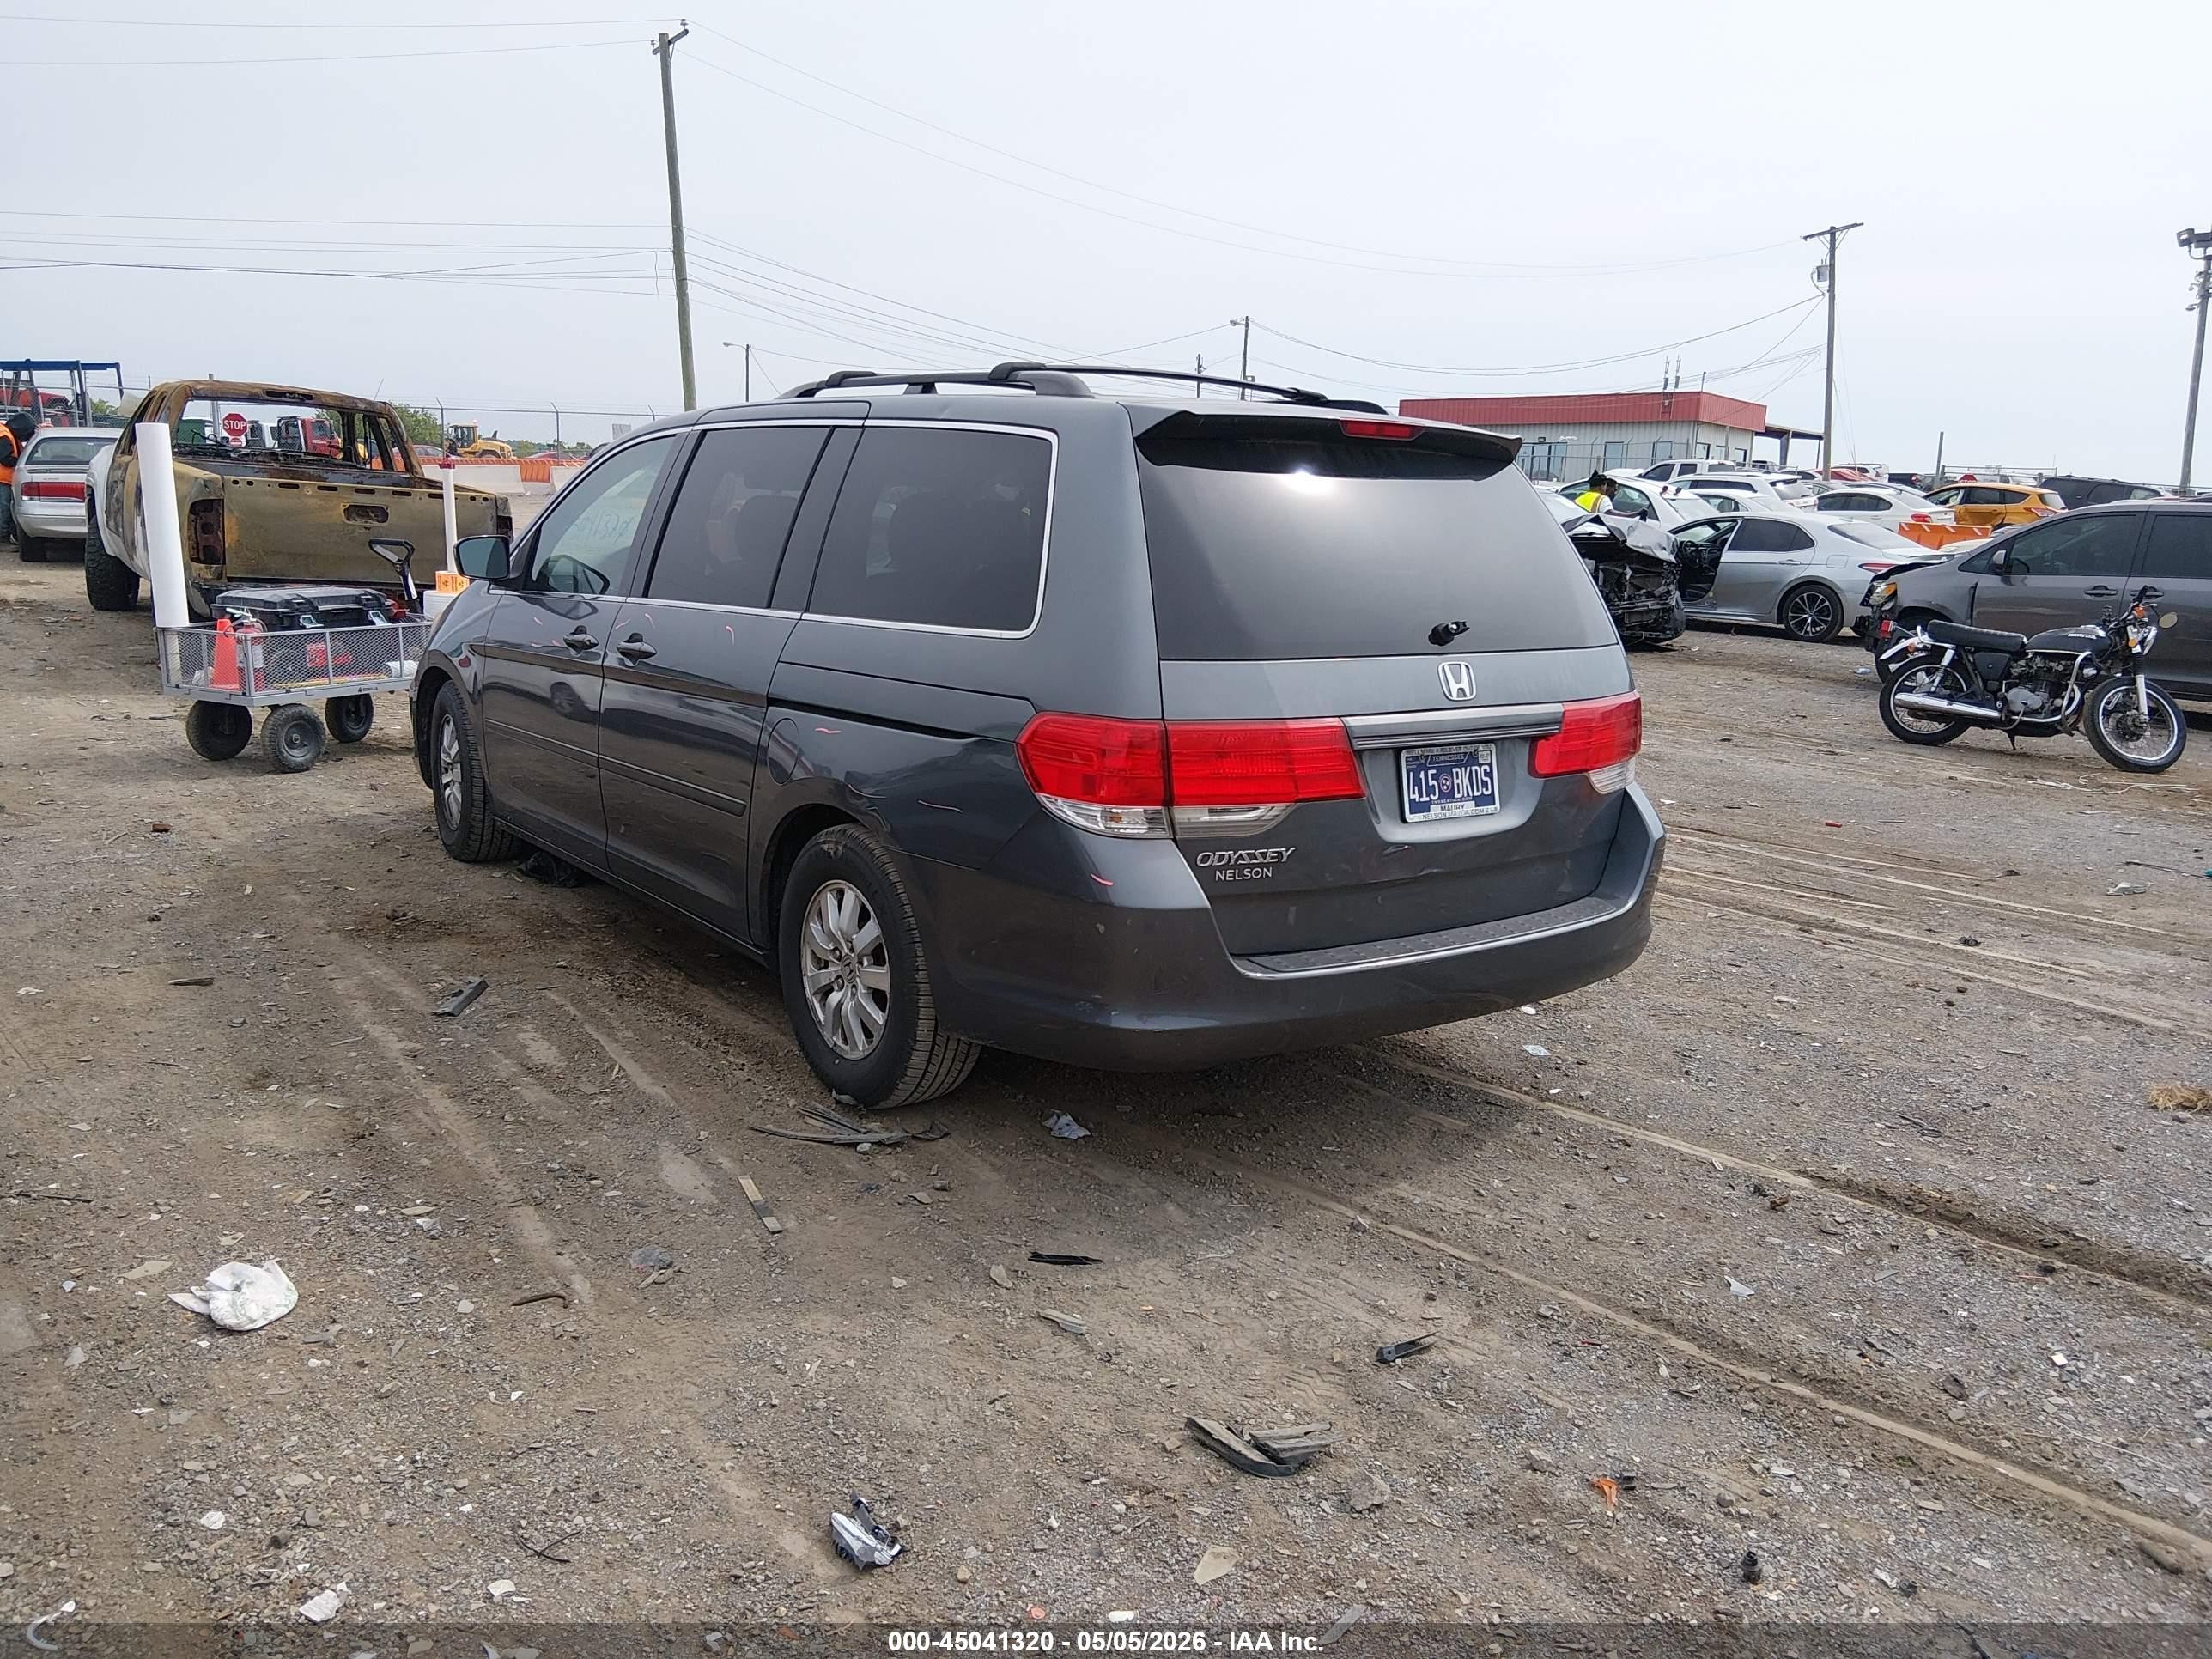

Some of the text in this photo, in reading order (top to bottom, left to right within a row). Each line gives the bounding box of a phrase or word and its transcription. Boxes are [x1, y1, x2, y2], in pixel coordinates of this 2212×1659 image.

[224, 420, 246, 430] STOP
[1409, 765, 1492, 802] 415 BKDS
[1196, 848, 1296, 867] ODYSSEY
[1215, 867, 1273, 881] NELSON
